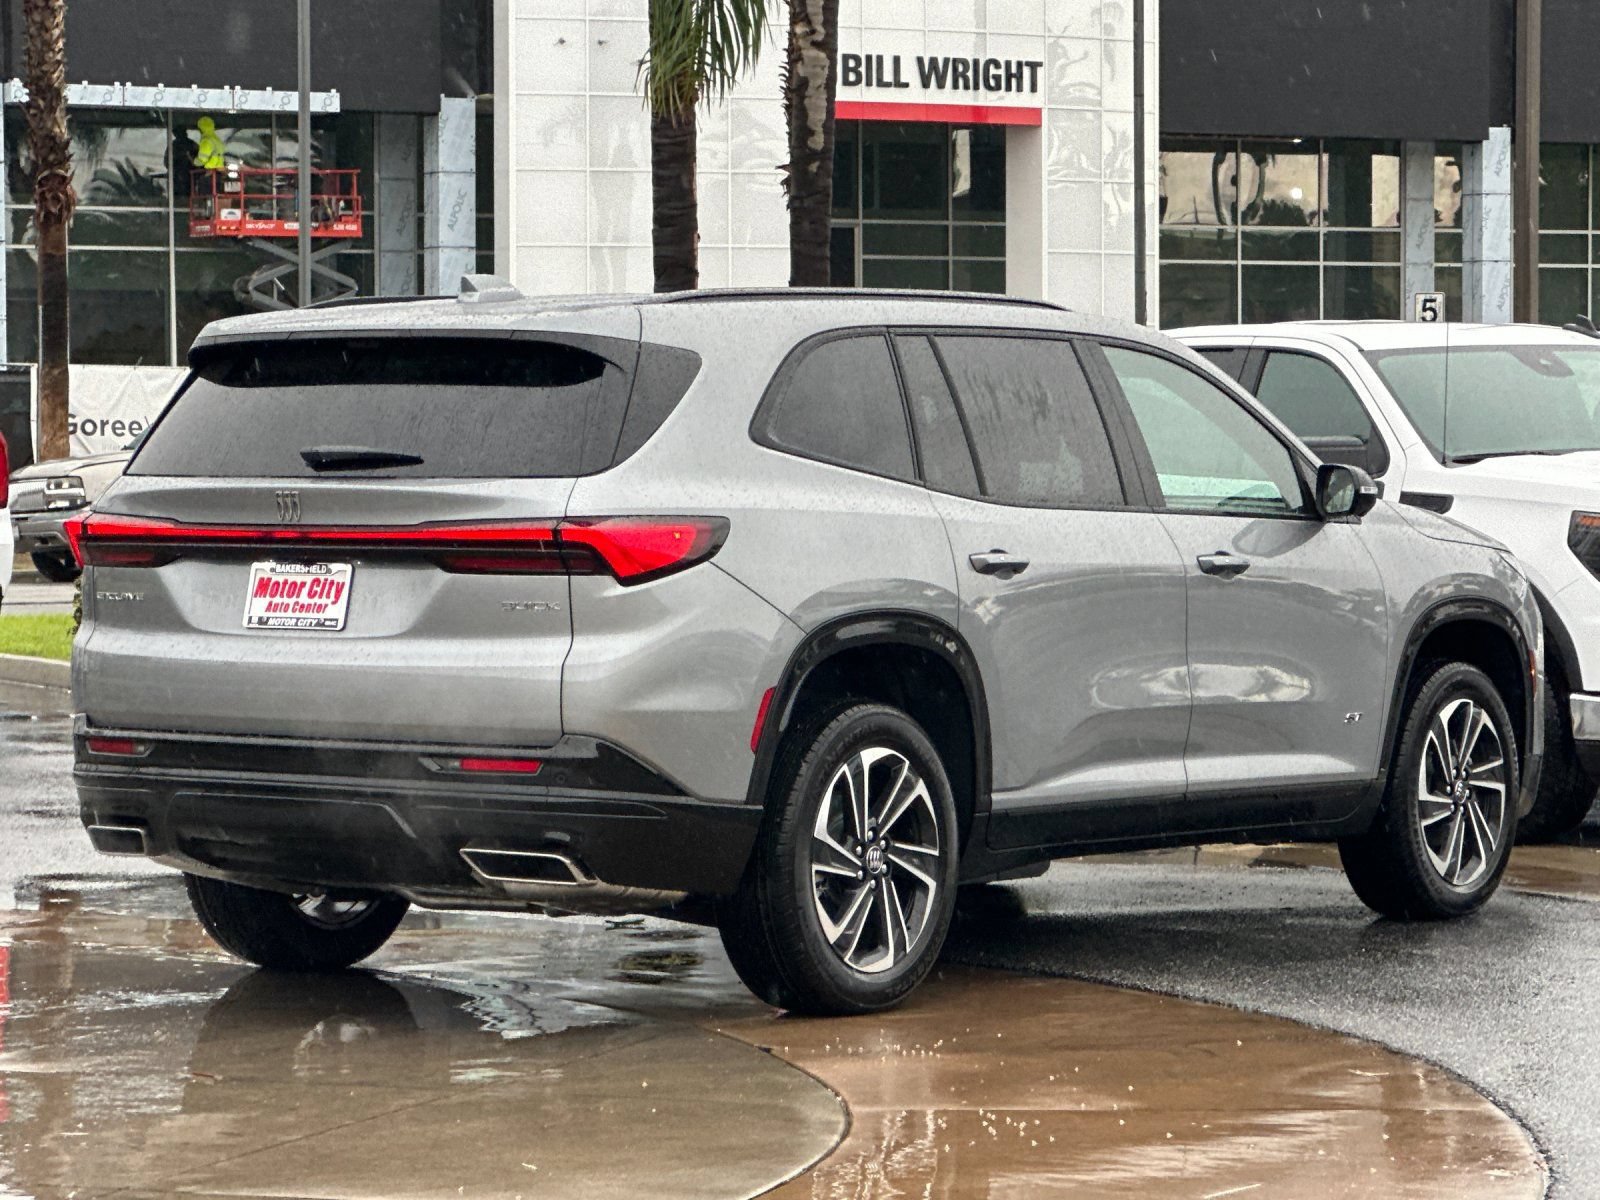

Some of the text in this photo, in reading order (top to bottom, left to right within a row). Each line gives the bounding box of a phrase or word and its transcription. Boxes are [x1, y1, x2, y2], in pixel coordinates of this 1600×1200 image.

[841, 53, 1044, 94] BILL WRIGHT
[448, 187, 468, 232] ALPOLIC
[1421, 298, 1438, 322] 5
[253, 577, 345, 605] Motor City
[265, 601, 328, 614] Auto Center
[267, 617, 295, 627] MOTOR
[297, 617, 318, 627] CITY
